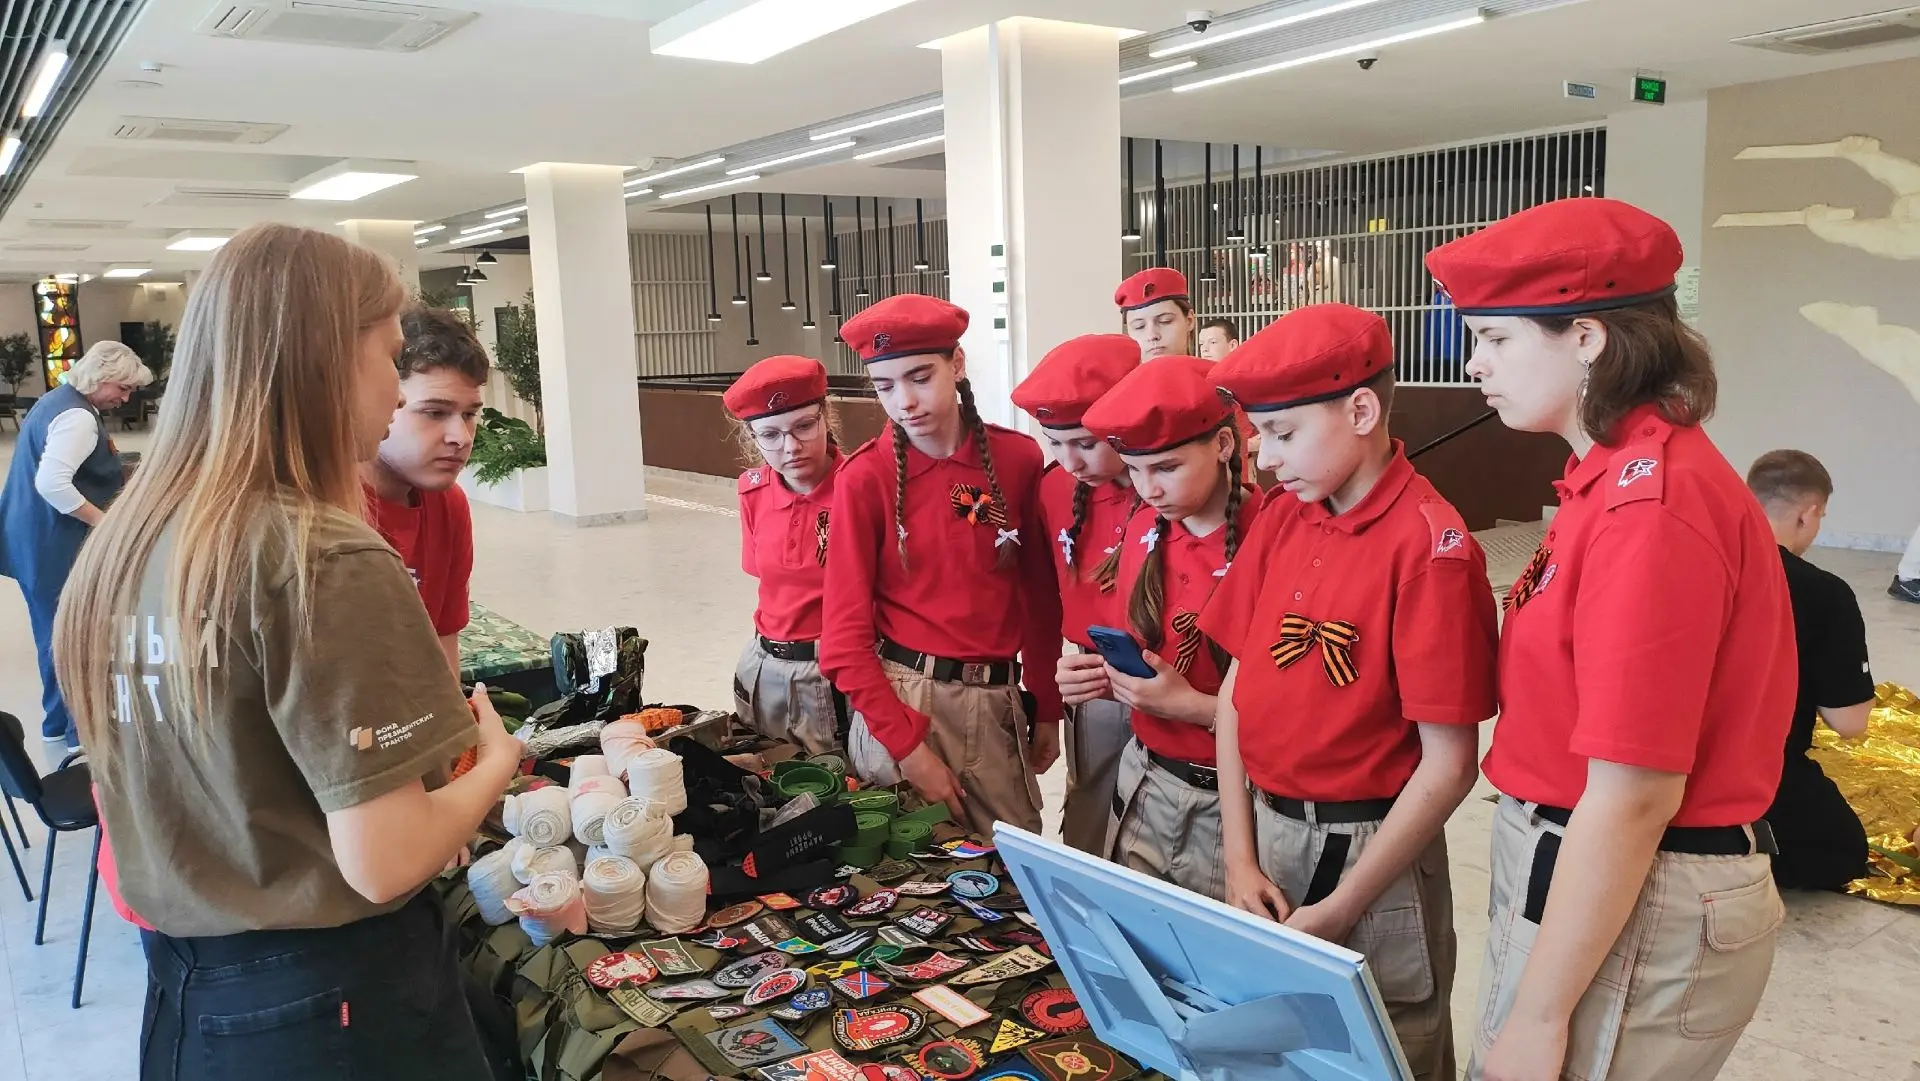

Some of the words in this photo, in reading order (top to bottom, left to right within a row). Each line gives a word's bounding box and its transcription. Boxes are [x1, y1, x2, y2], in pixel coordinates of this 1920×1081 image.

[375, 722, 399, 736] ФОНД
[377, 712, 435, 743] ПРЕЗИДЕНТСКИХ
[380, 732, 413, 750] ГРАНТОВ
